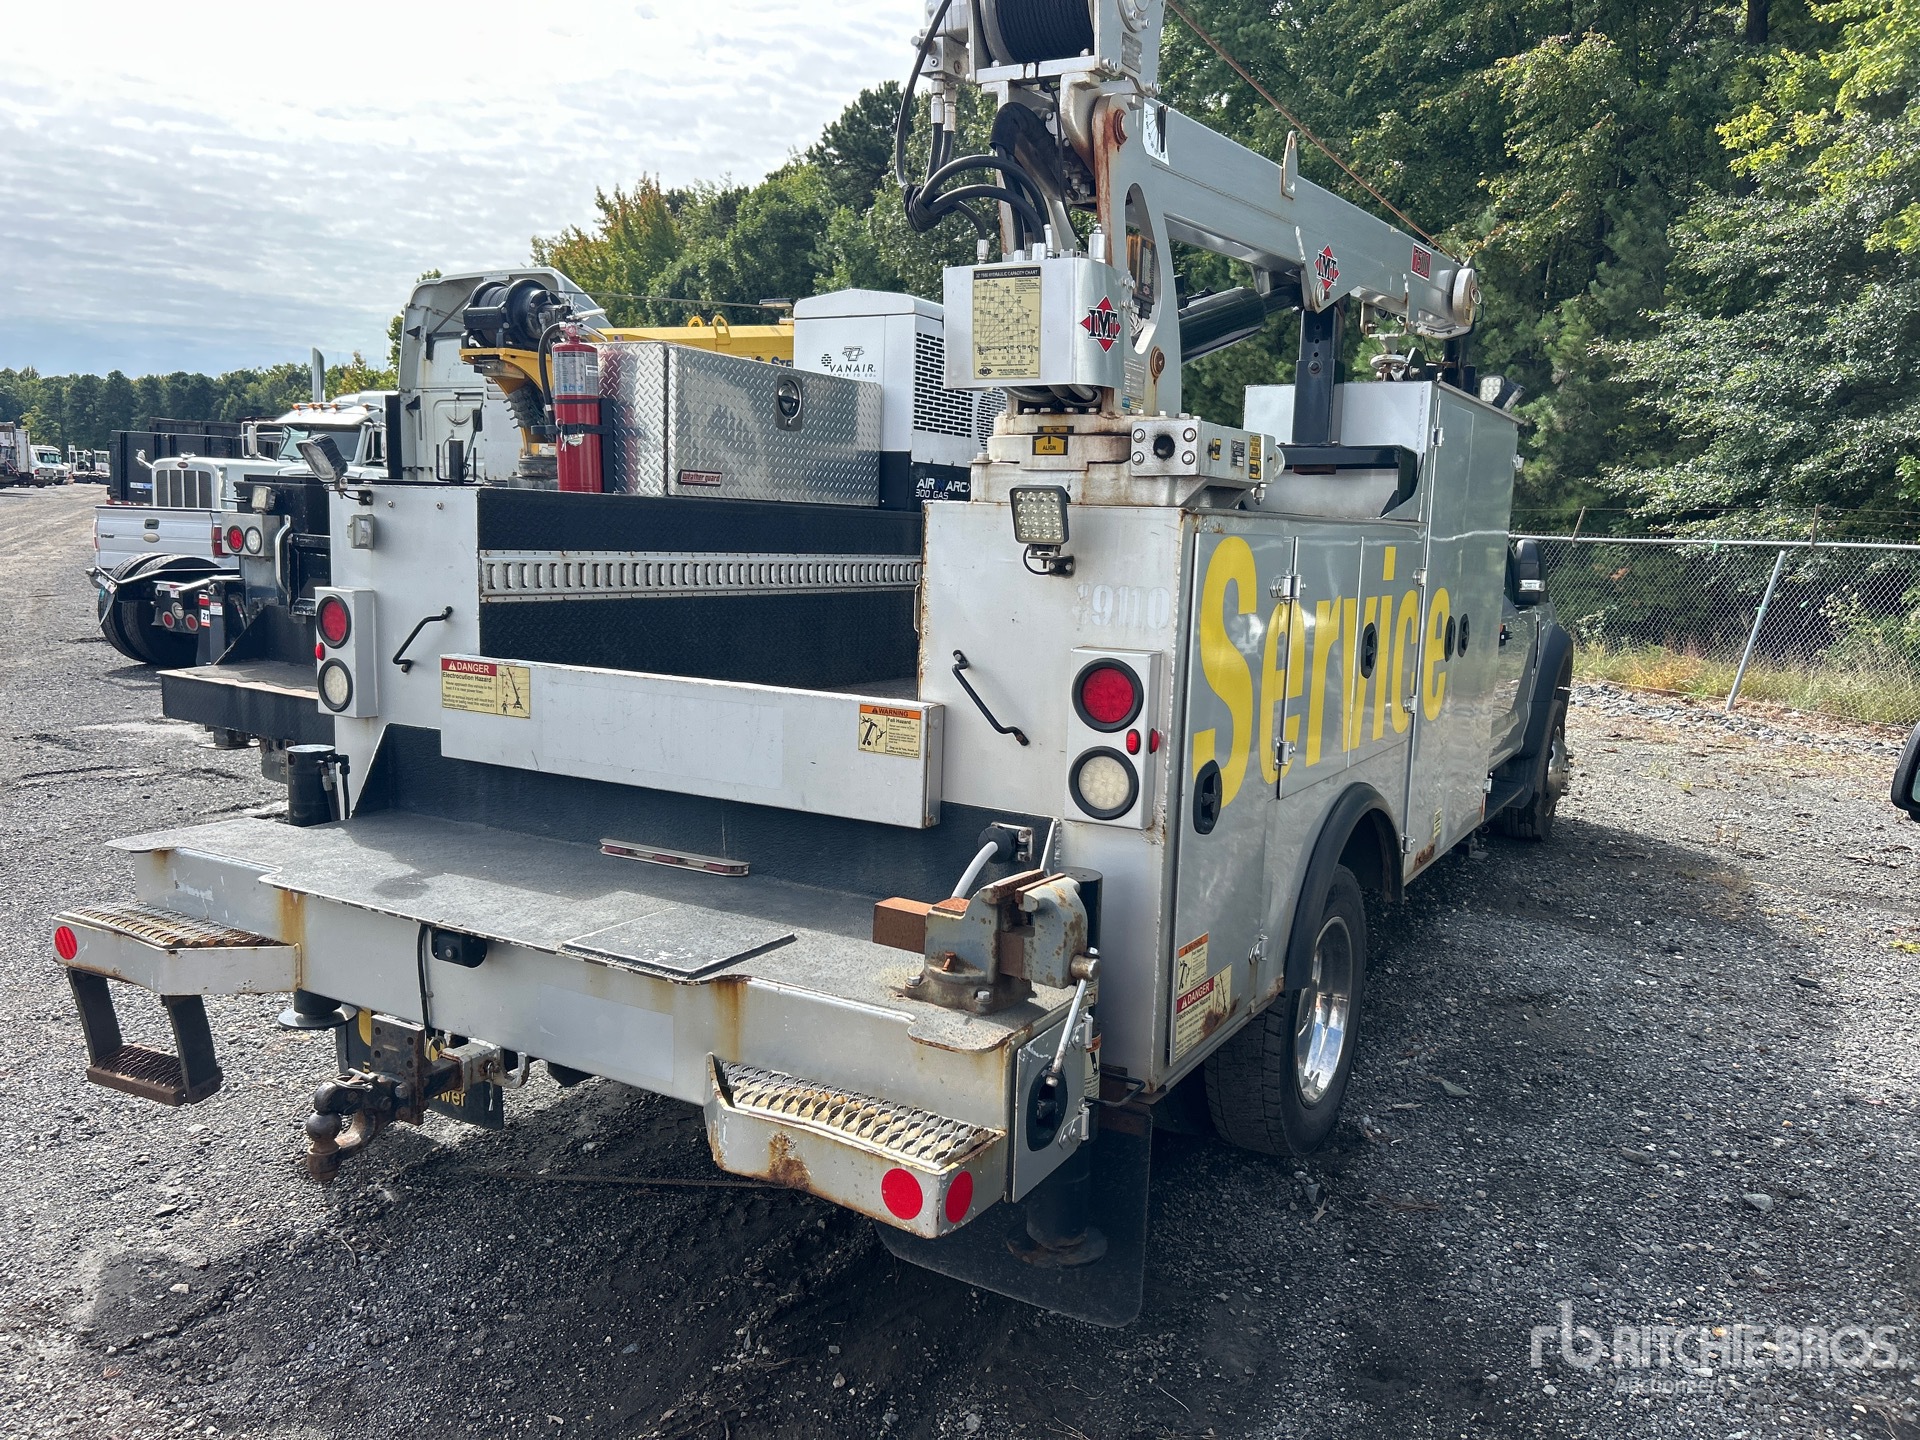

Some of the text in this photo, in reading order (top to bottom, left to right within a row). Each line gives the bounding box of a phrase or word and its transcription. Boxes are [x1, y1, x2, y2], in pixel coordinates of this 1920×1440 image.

[1089, 308, 1118, 340] IMT
[916, 477, 935, 490] AIR
[915, 489, 949, 500] 300 GAS
[456, 661, 490, 674] DANGER
[1193, 536, 1451, 809] Service
[442, 671, 492, 683] Electrocution Hazard
[879, 707, 909, 718] WARNING
[1187, 981, 1210, 1004] DANGER
